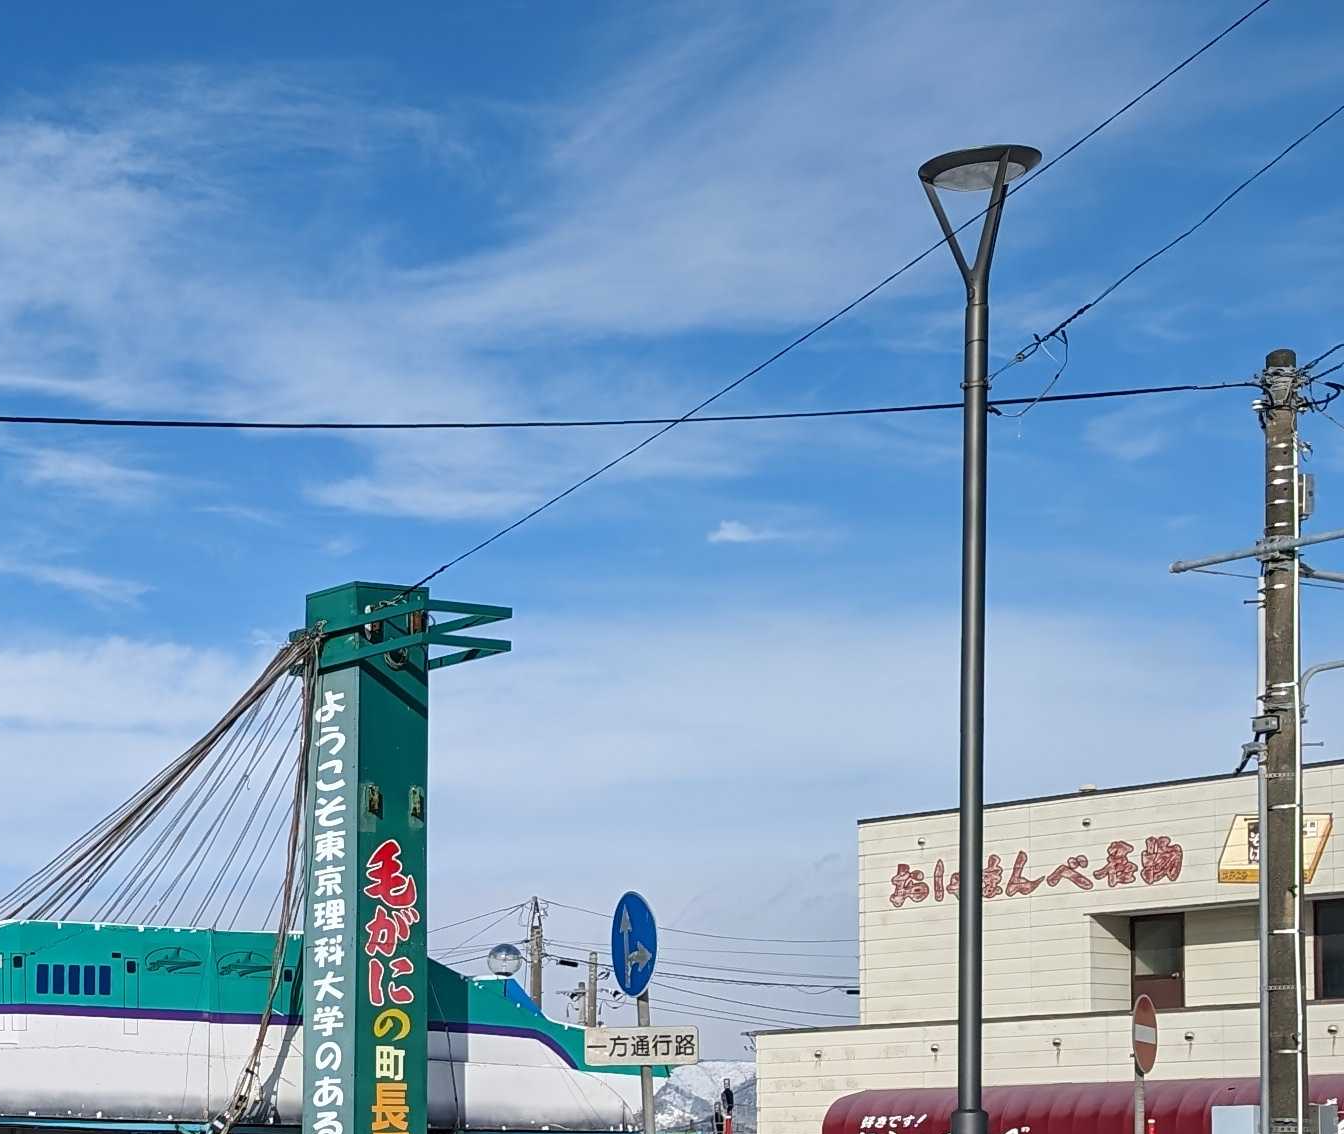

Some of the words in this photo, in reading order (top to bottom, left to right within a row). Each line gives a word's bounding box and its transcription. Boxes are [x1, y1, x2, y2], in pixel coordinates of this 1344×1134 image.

[586, 1034, 696, 1058] 一方通行路
[860, 1114, 927, 1129] 好きです!
